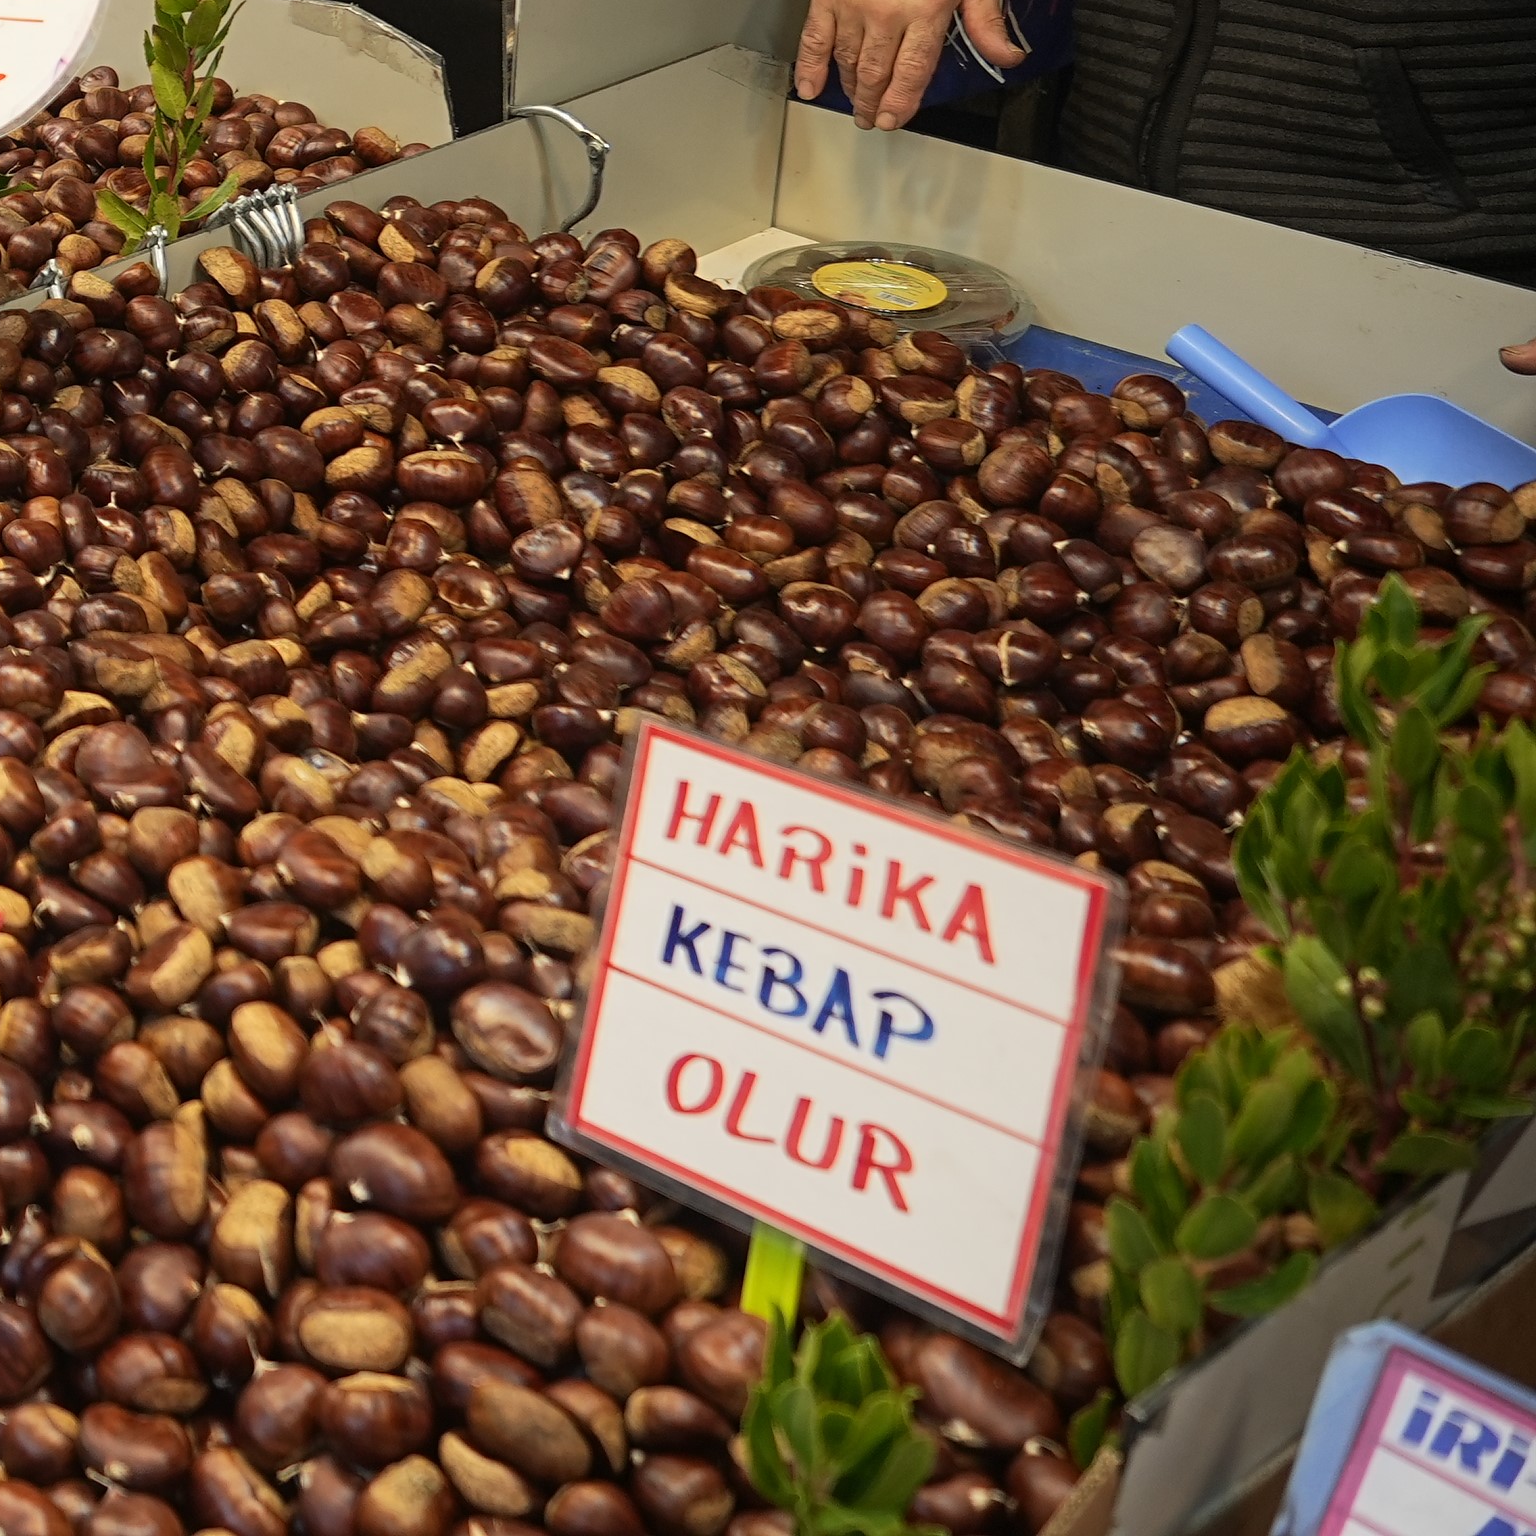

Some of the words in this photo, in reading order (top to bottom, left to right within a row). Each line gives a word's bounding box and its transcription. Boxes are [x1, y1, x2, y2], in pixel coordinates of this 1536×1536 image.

[664, 779, 999, 966] HARİKA
[659, 904, 937, 1063] KEBAP
[664, 1051, 916, 1215] OLUR
